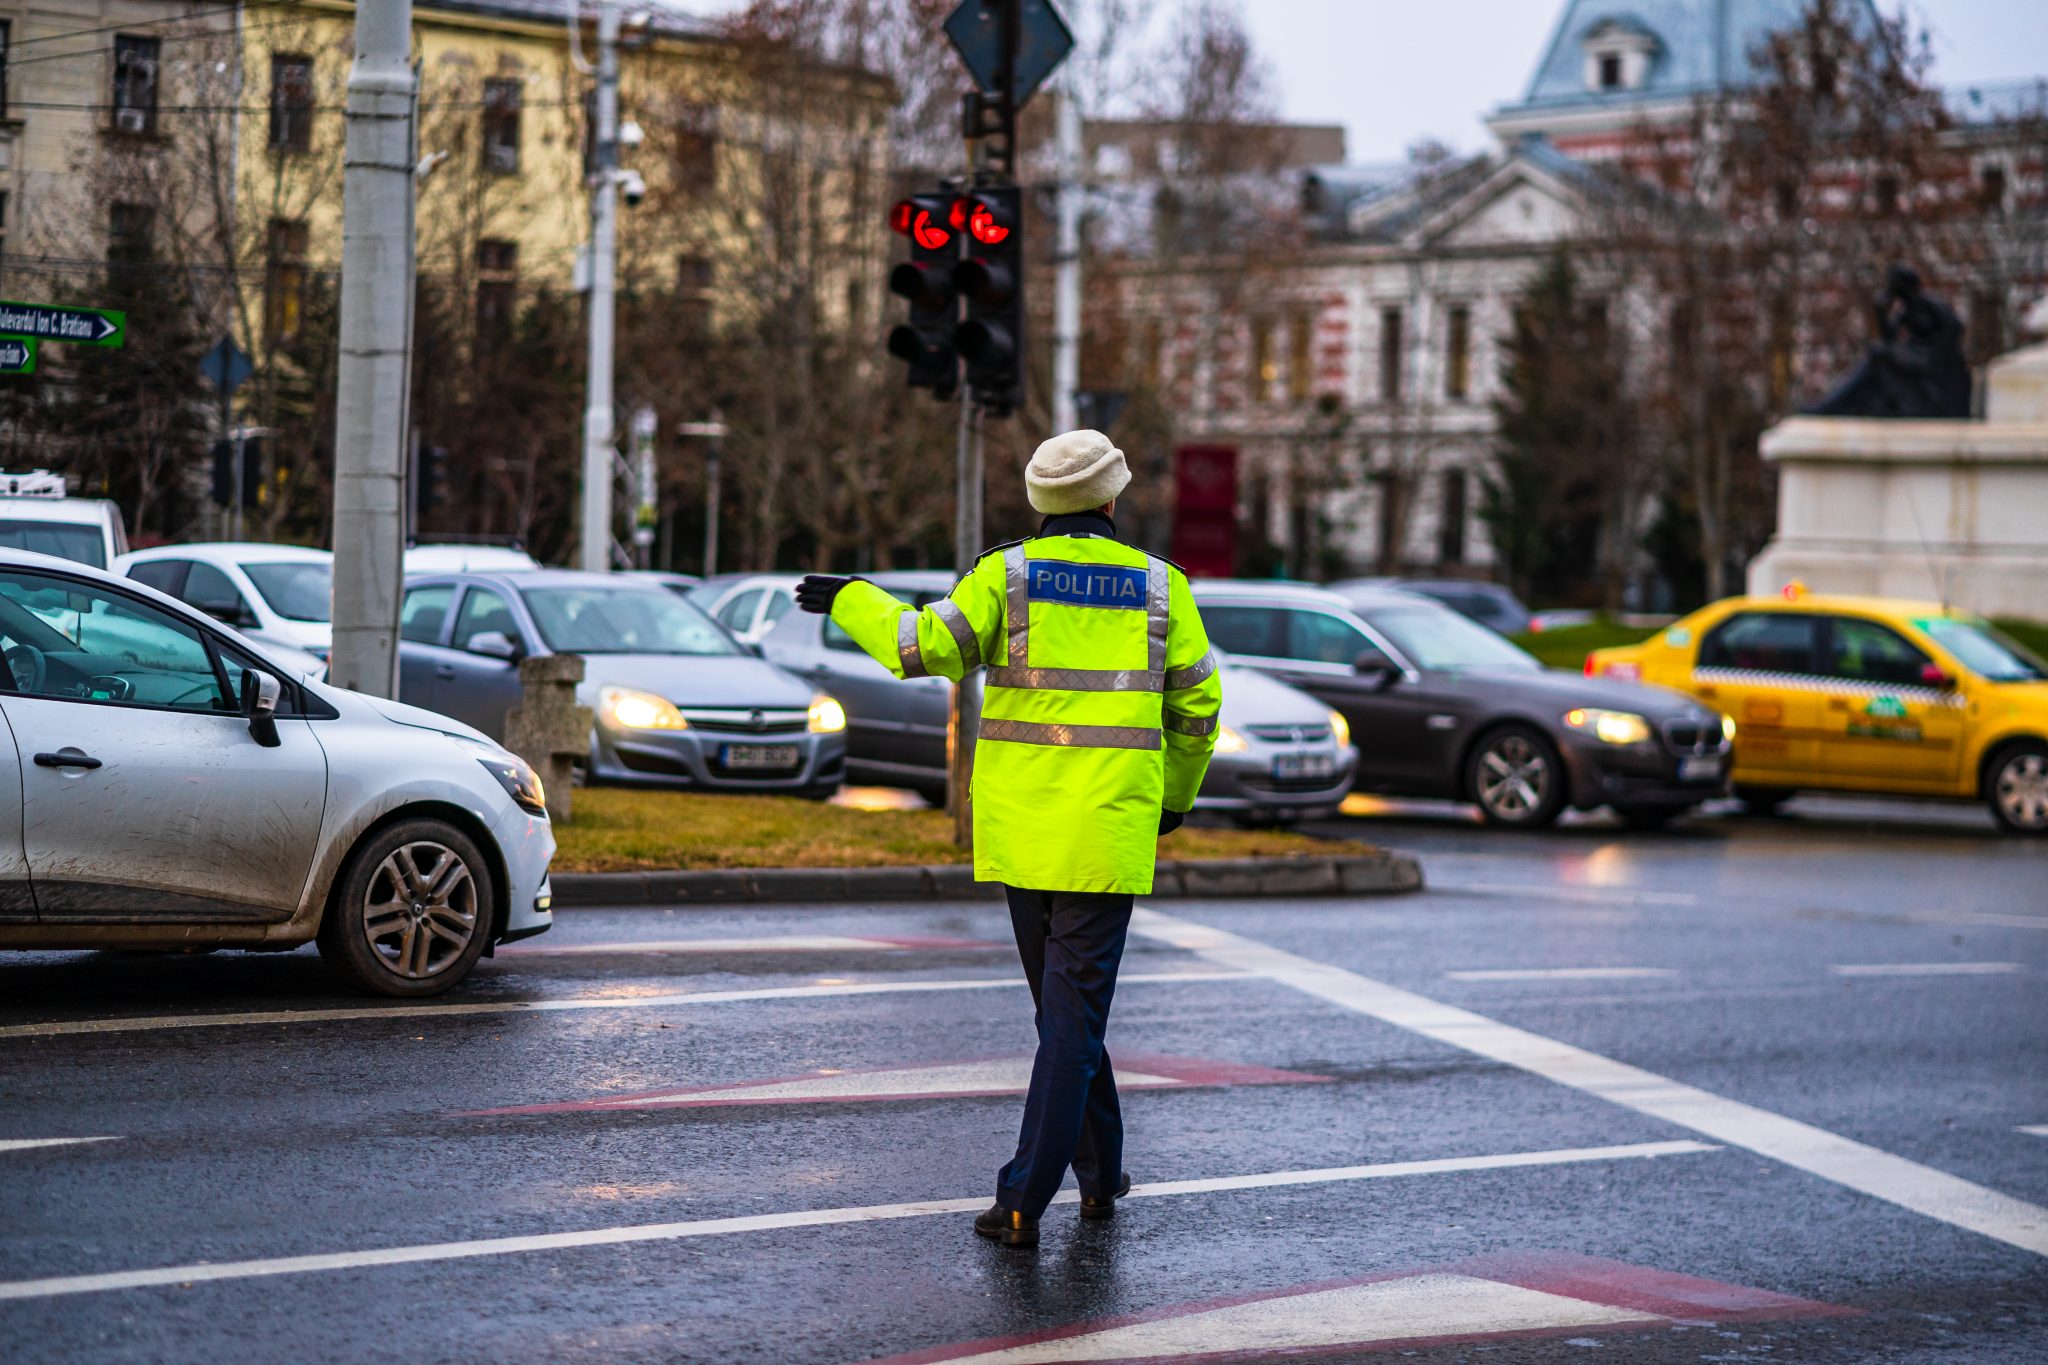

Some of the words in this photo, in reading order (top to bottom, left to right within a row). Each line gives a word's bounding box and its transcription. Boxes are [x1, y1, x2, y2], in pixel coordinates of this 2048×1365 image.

[0, 307, 36, 332] ulevardul
[37, 310, 49, 334] Ion
[51, 311, 59, 334] C.
[1036, 569, 1137, 597] POLITIA
